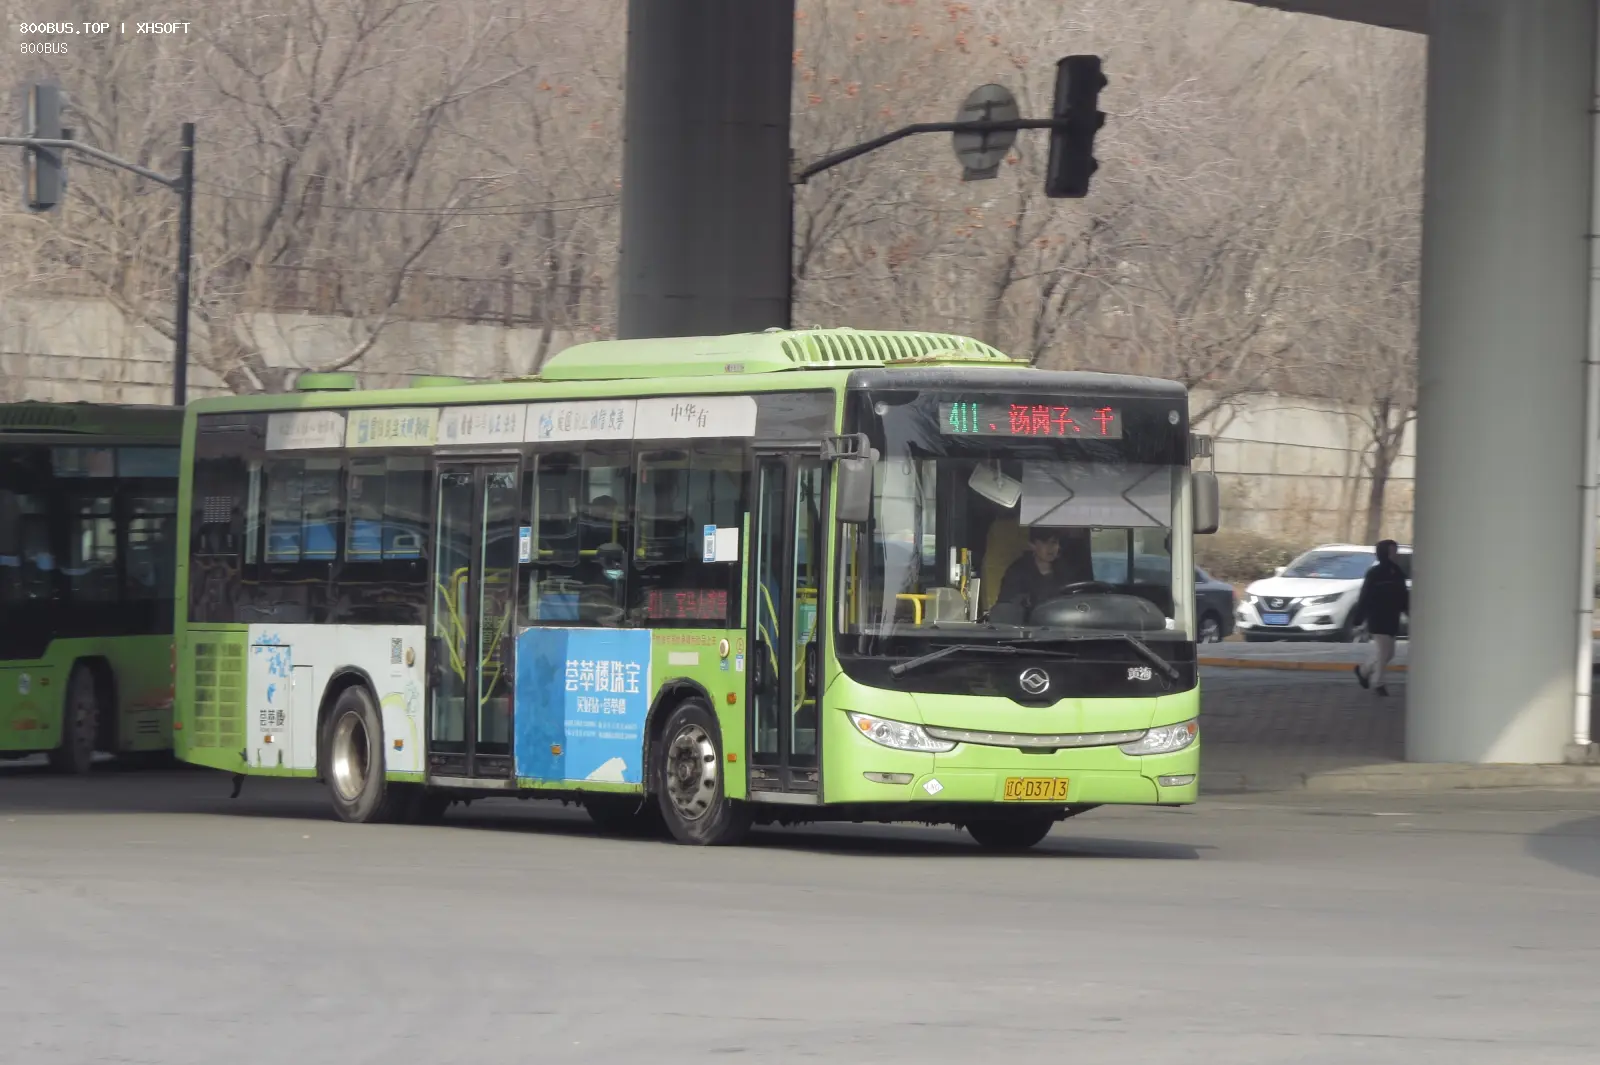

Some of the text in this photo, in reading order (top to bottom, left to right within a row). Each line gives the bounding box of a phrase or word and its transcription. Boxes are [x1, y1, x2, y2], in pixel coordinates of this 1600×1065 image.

[565, 659, 641, 694] 荟萃楼珠宝
[1127, 666, 1152, 681] 黄海
